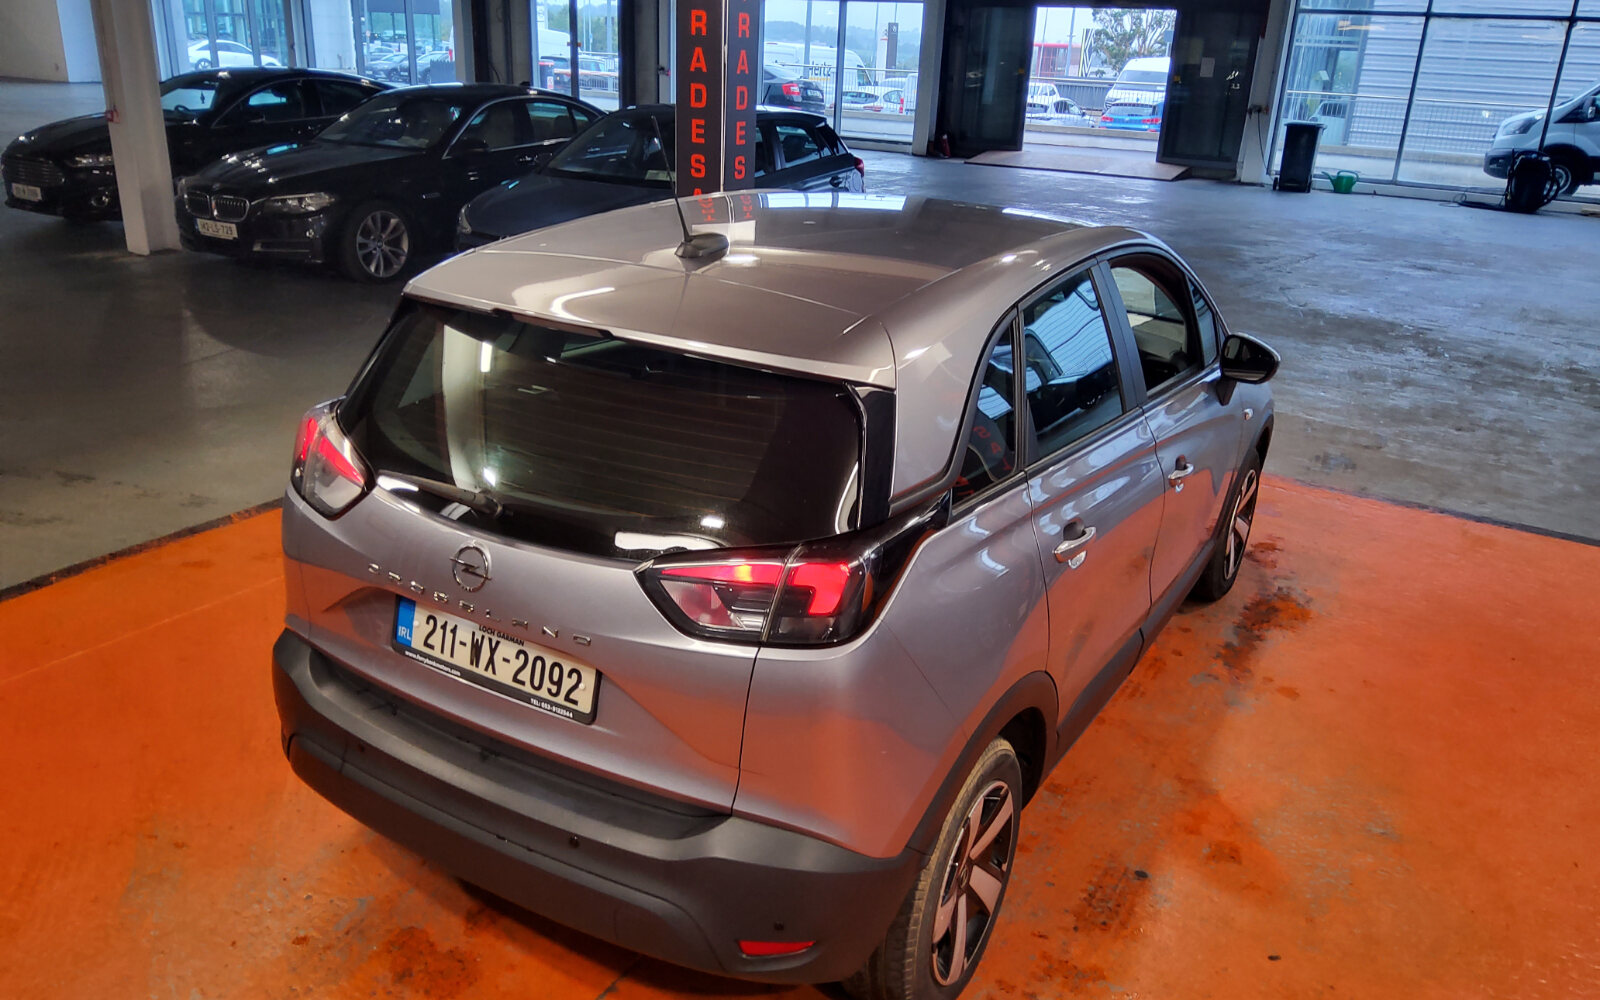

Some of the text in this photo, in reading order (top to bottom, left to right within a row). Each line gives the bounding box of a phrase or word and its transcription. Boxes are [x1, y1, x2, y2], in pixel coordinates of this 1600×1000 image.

[733, 0, 750, 180] RADES
[397, 625, 412, 641] IRL
[422, 613, 583, 706] 211-WX-2092
[479, 624, 525, 647] LOCH GARMAN
